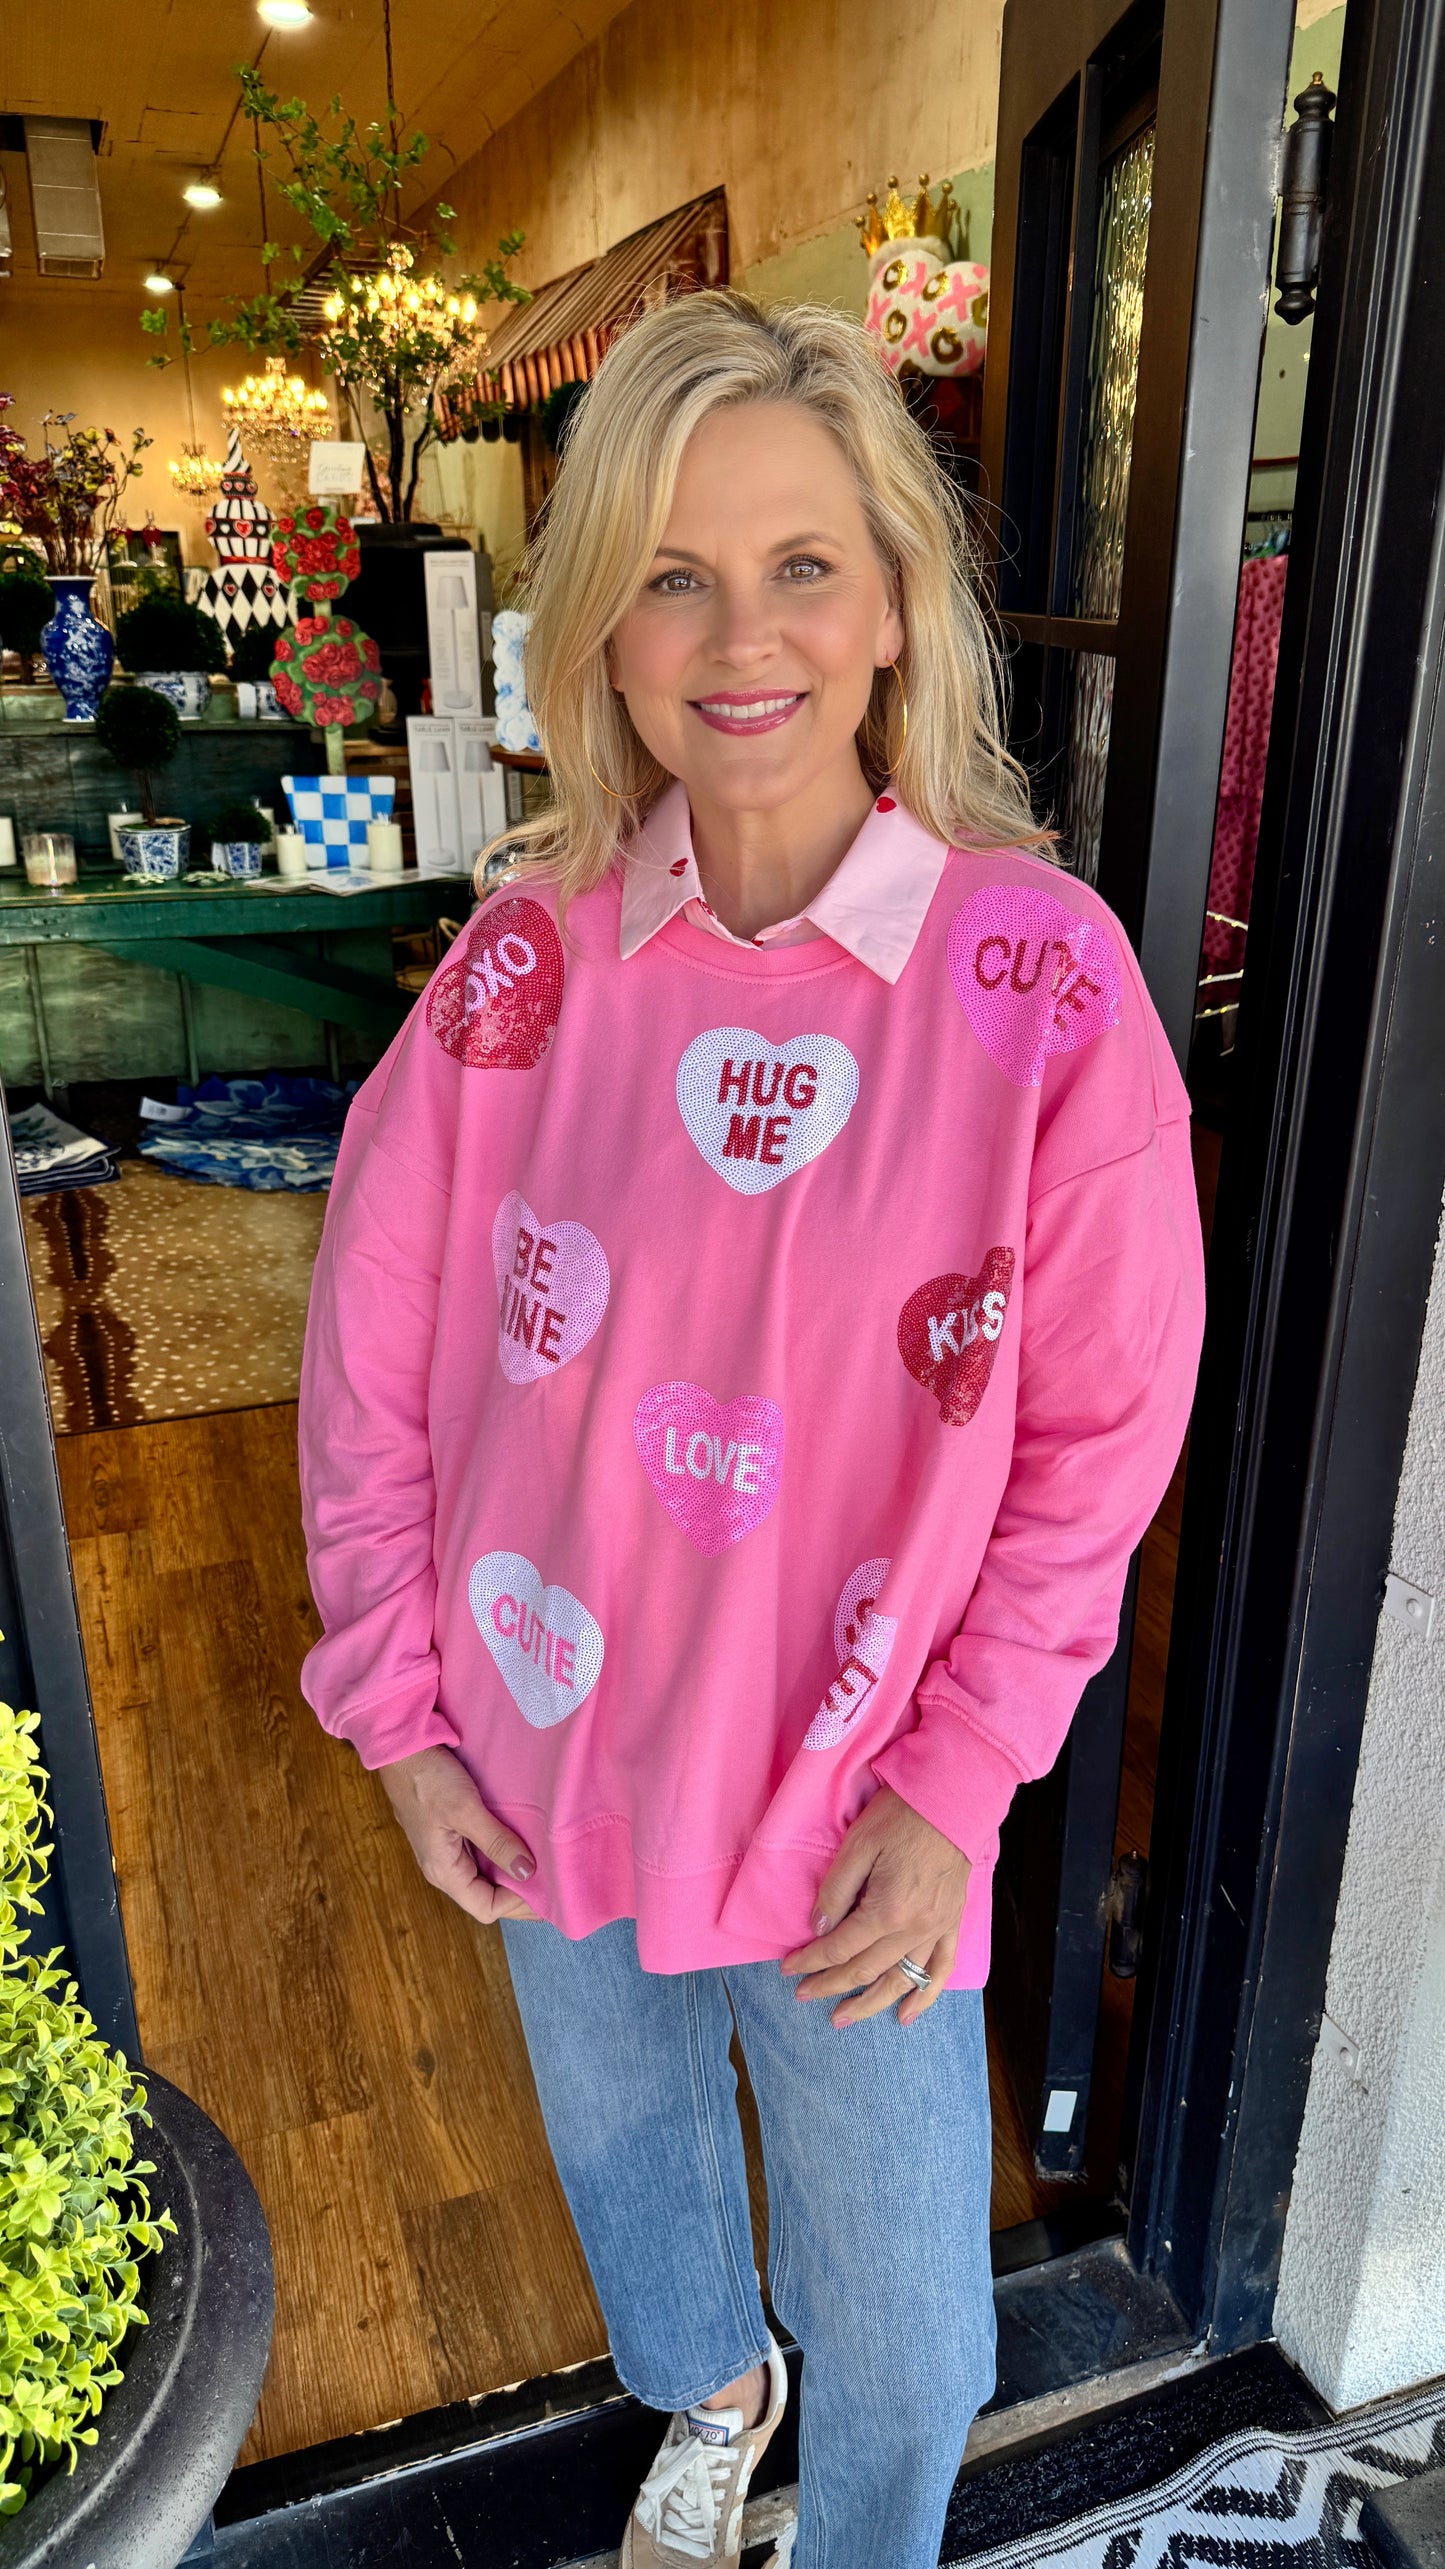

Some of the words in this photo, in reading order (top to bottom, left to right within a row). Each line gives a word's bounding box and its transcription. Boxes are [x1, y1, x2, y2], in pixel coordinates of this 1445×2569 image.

[717, 1058, 818, 1110] HUG
[722, 1113, 792, 1165] ME
[513, 1227, 557, 1294] BE
[665, 1426, 761, 1494] LOVE
[490, 1593, 576, 1692] CUTIE
